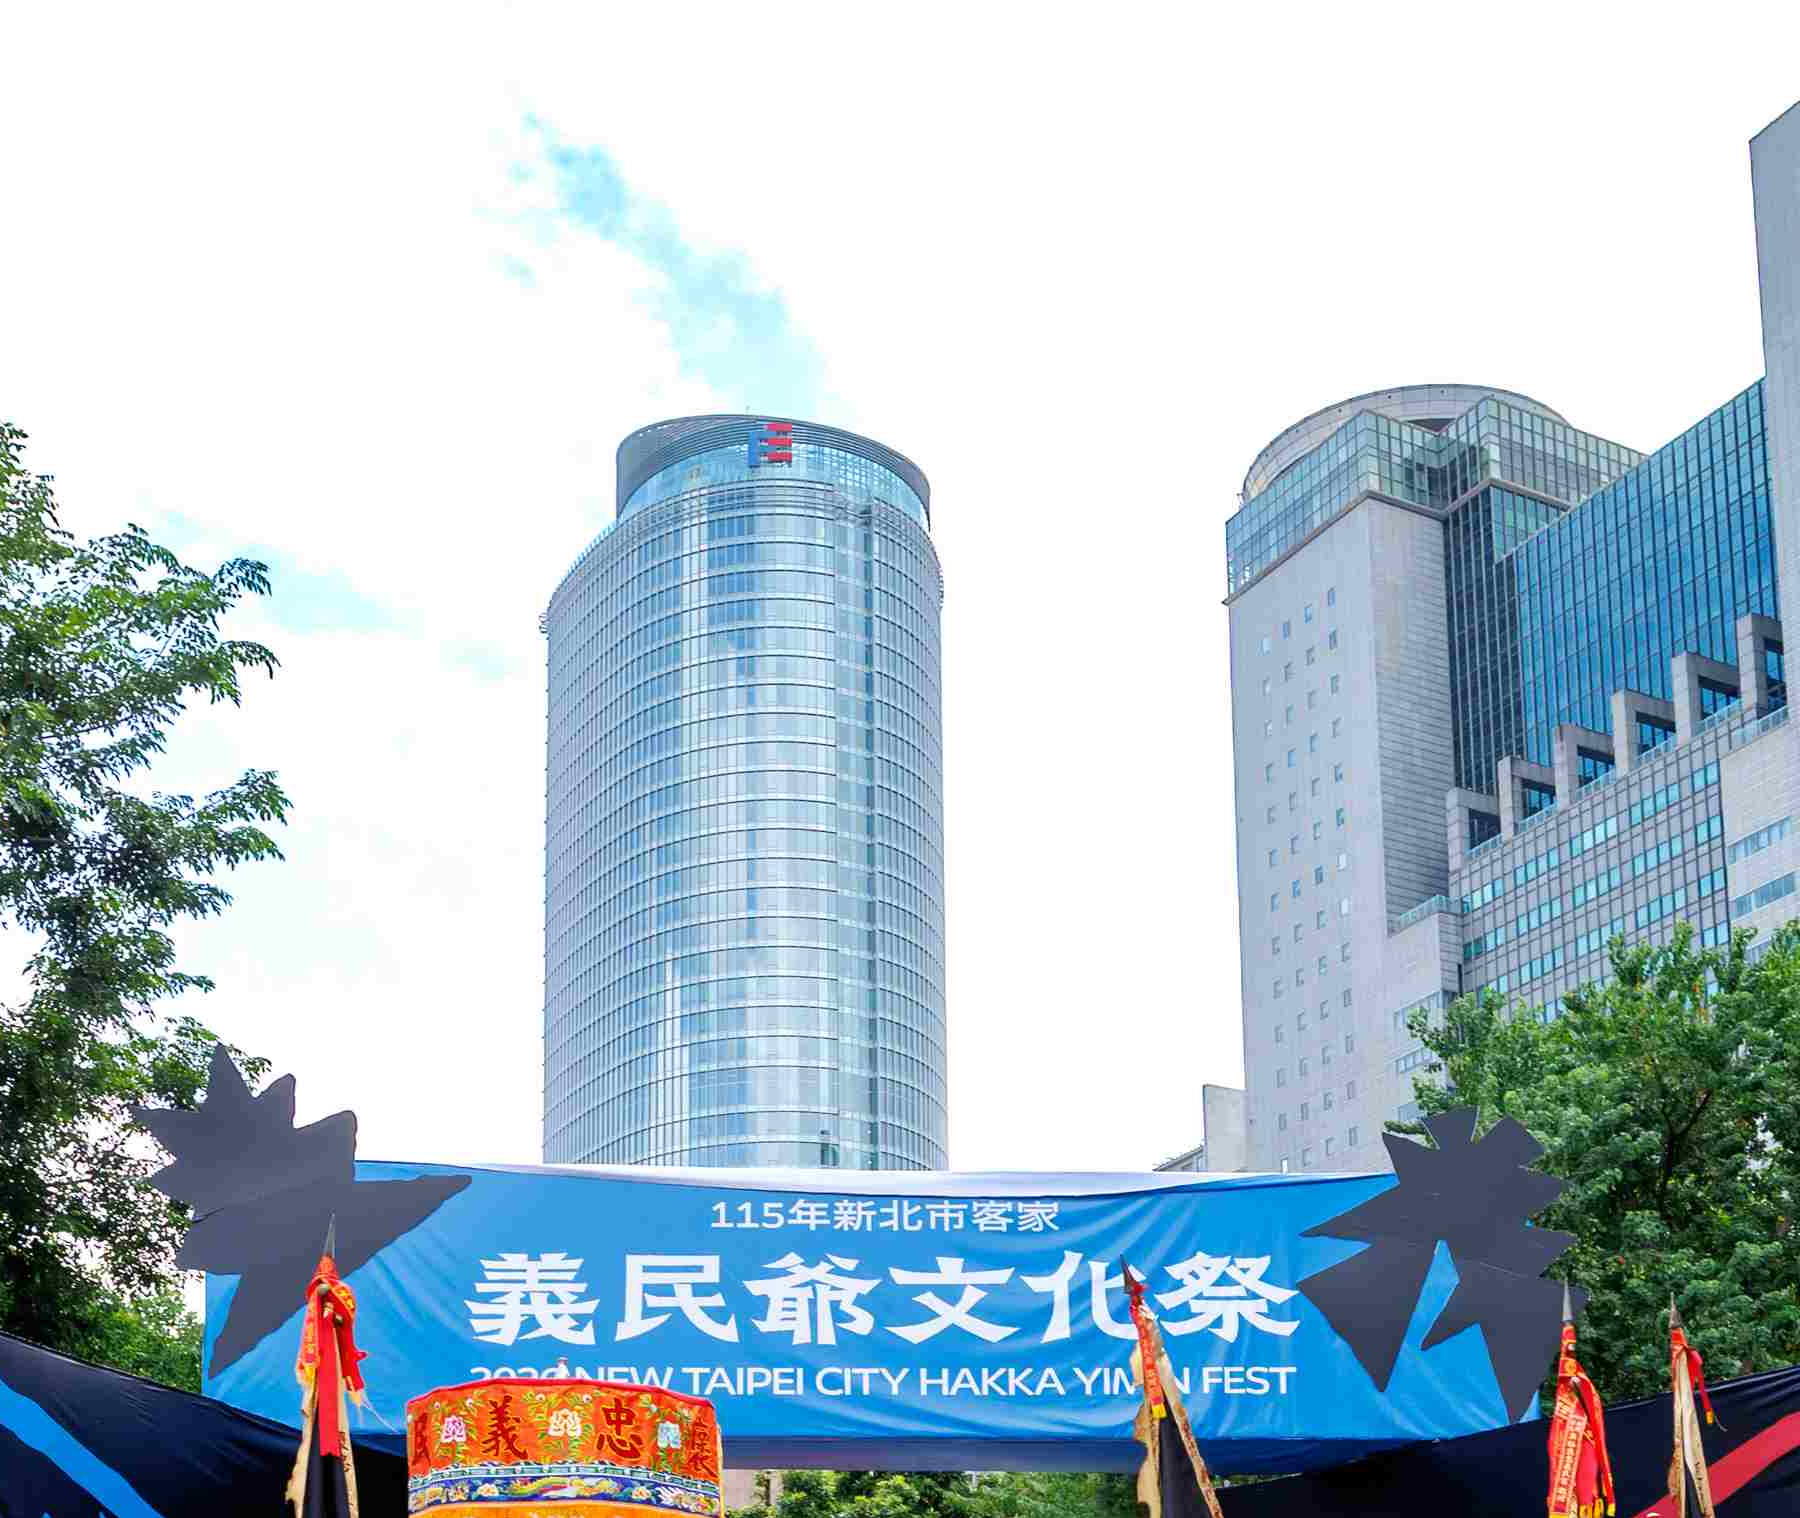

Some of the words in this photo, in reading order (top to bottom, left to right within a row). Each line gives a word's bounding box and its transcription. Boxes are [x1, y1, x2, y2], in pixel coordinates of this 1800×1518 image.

[711, 1199, 1059, 1232] 115年新北市客家
[464, 1250, 1300, 1346] 義民爺文化祭
[681, 1366, 808, 1396] TAIPEI
[815, 1366, 912, 1396] CITY
[919, 1366, 1066, 1396] HAKKA
[1072, 1366, 1191, 1395] YIMN
[1202, 1365, 1297, 1395] FEST
